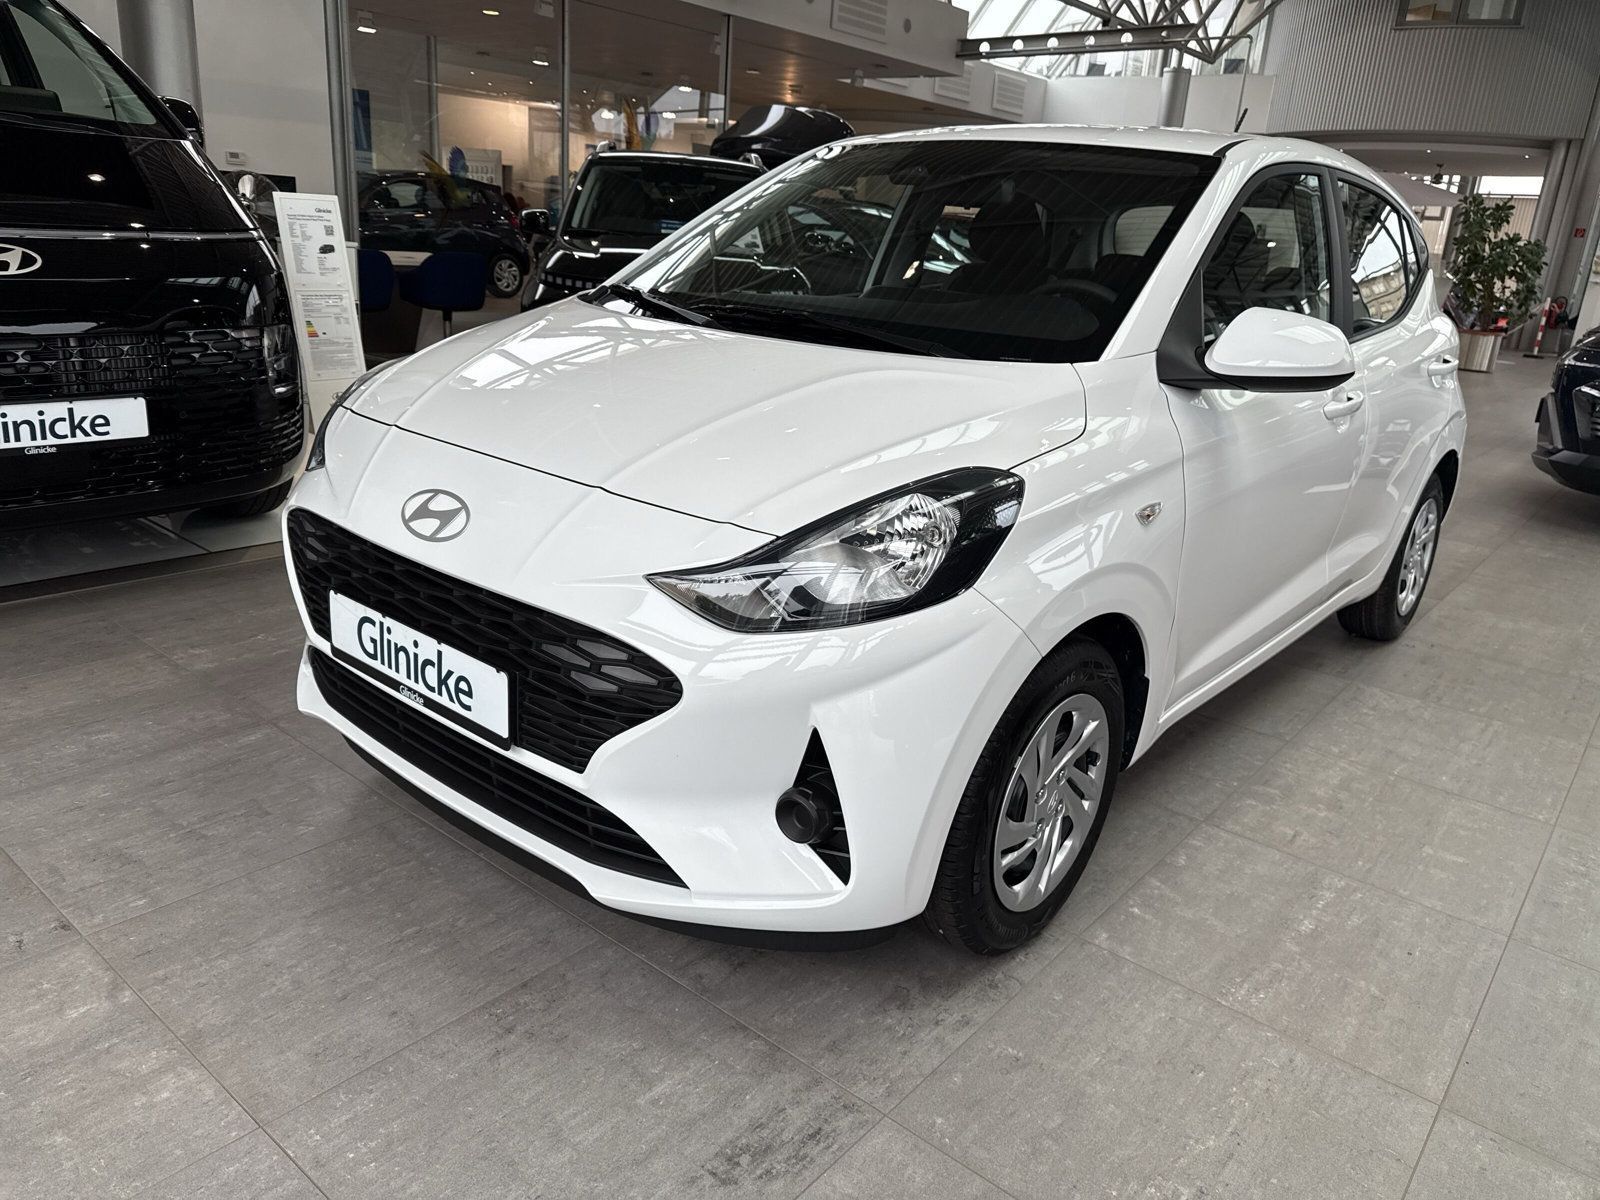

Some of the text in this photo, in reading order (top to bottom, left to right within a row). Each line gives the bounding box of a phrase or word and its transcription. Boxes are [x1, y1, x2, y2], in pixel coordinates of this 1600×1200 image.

[0, 407, 111, 443] inicke
[25, 446, 57, 455] Glinicke
[357, 616, 474, 712] Glinicke
[400, 685, 425, 706] Glinicke
